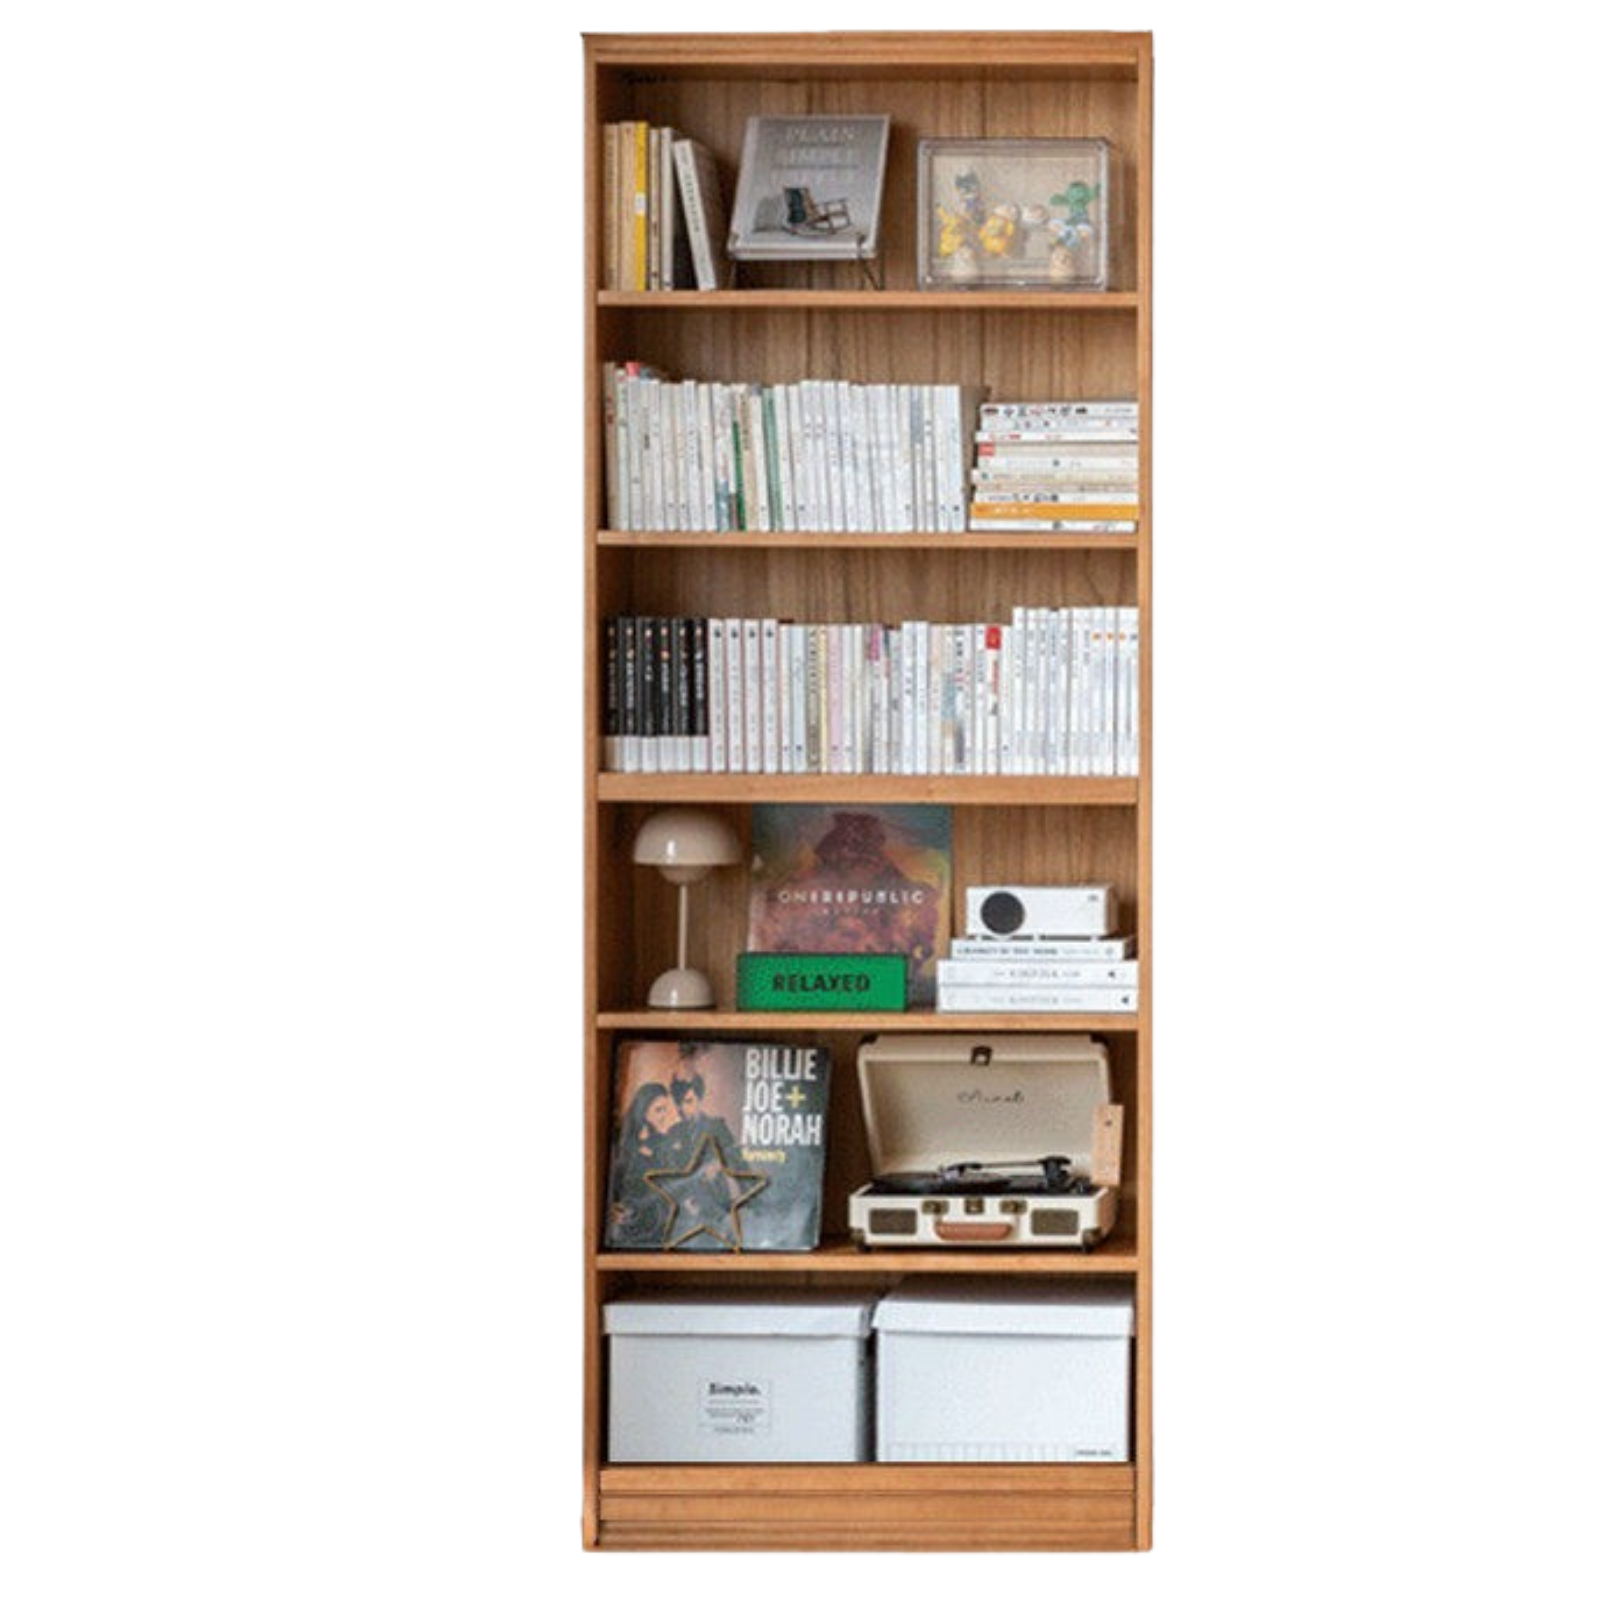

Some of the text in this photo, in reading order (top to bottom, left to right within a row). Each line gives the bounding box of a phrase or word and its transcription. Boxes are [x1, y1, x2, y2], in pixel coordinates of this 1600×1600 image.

[771, 972, 871, 993] RELAXED
[746, 1048, 818, 1080] BILLIE
[741, 1113, 822, 1146] NORAH
